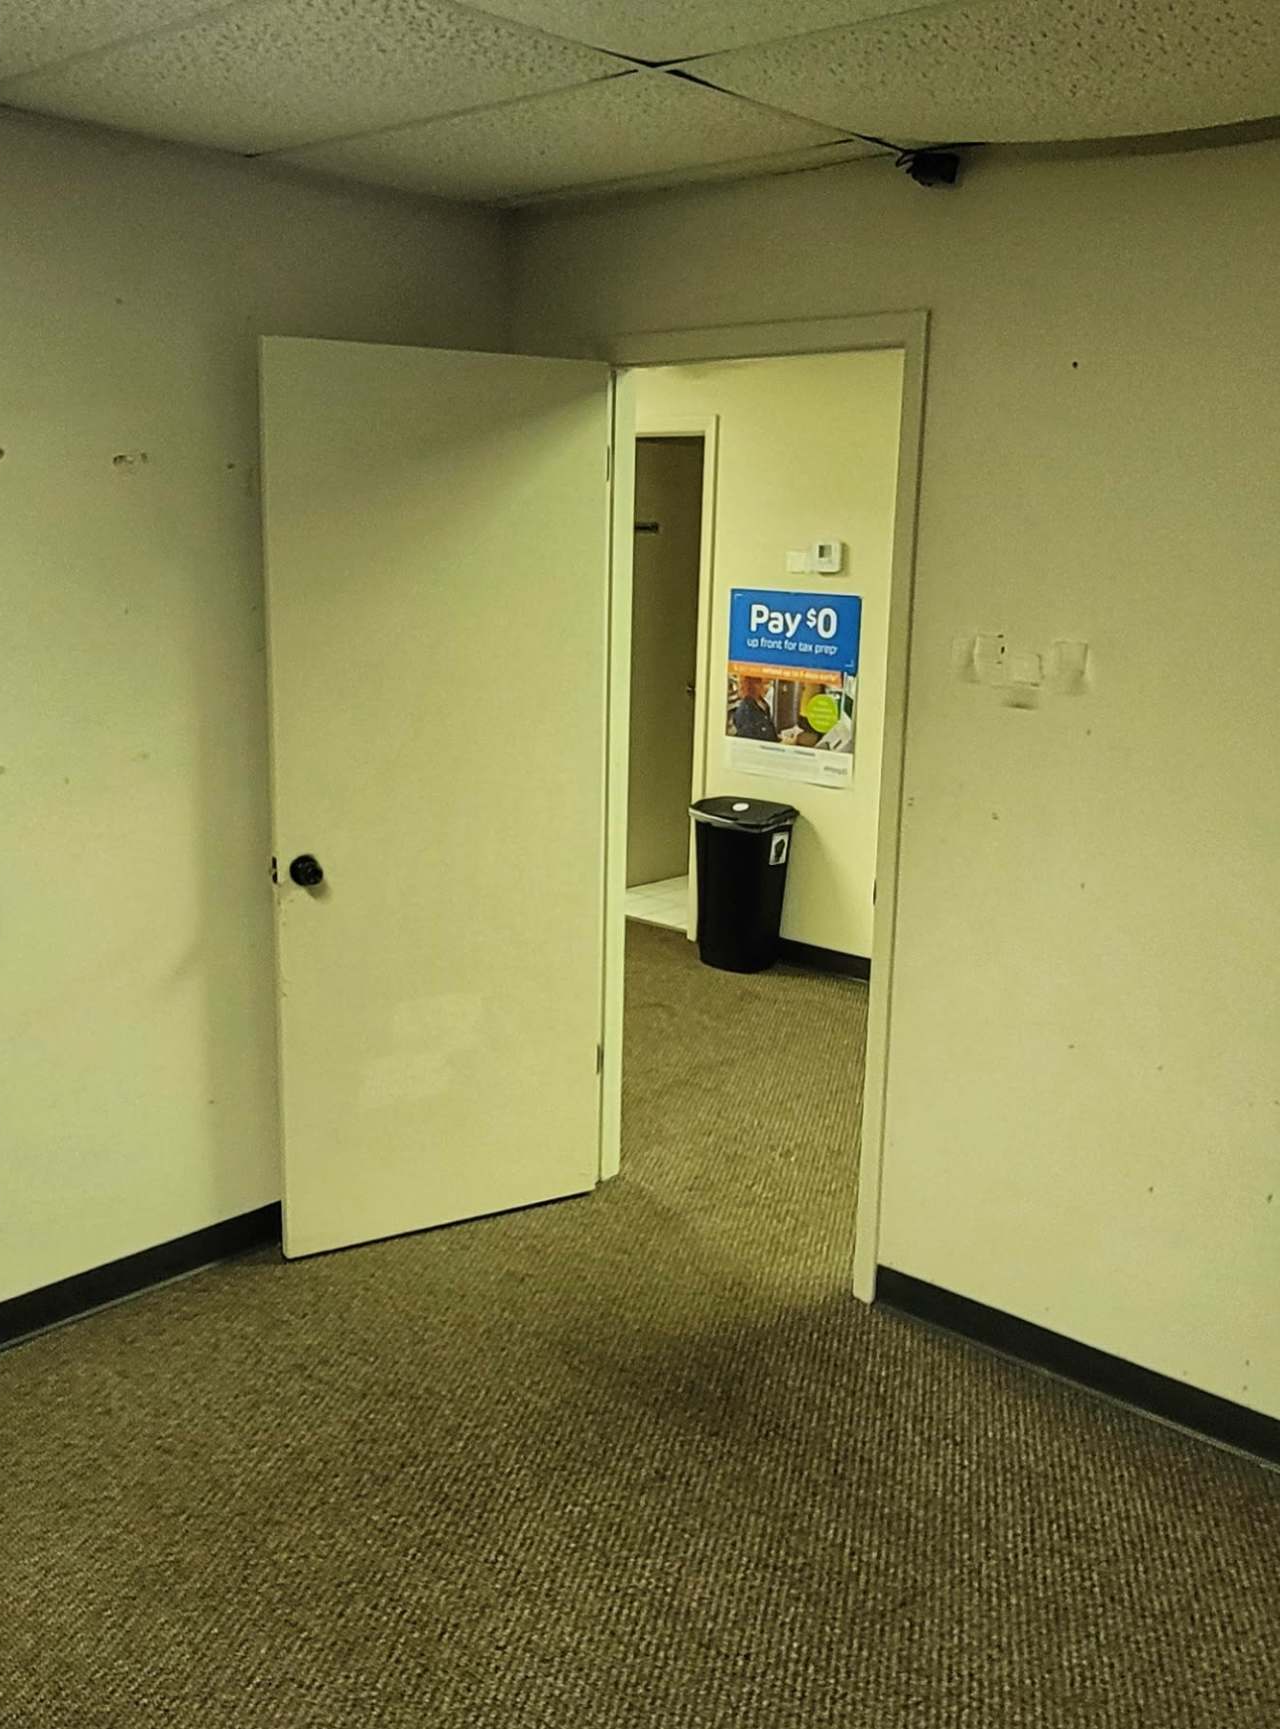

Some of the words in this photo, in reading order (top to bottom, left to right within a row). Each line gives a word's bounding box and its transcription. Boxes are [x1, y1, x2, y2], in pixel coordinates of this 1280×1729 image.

[751, 604, 801, 637] Pay
[807, 607, 837, 639] $0
[747, 638, 759, 648] up
[760, 637, 783, 650] front
[784, 640, 797, 651] for
[798, 642, 812, 652] tax
[814, 644, 838, 655] prep
